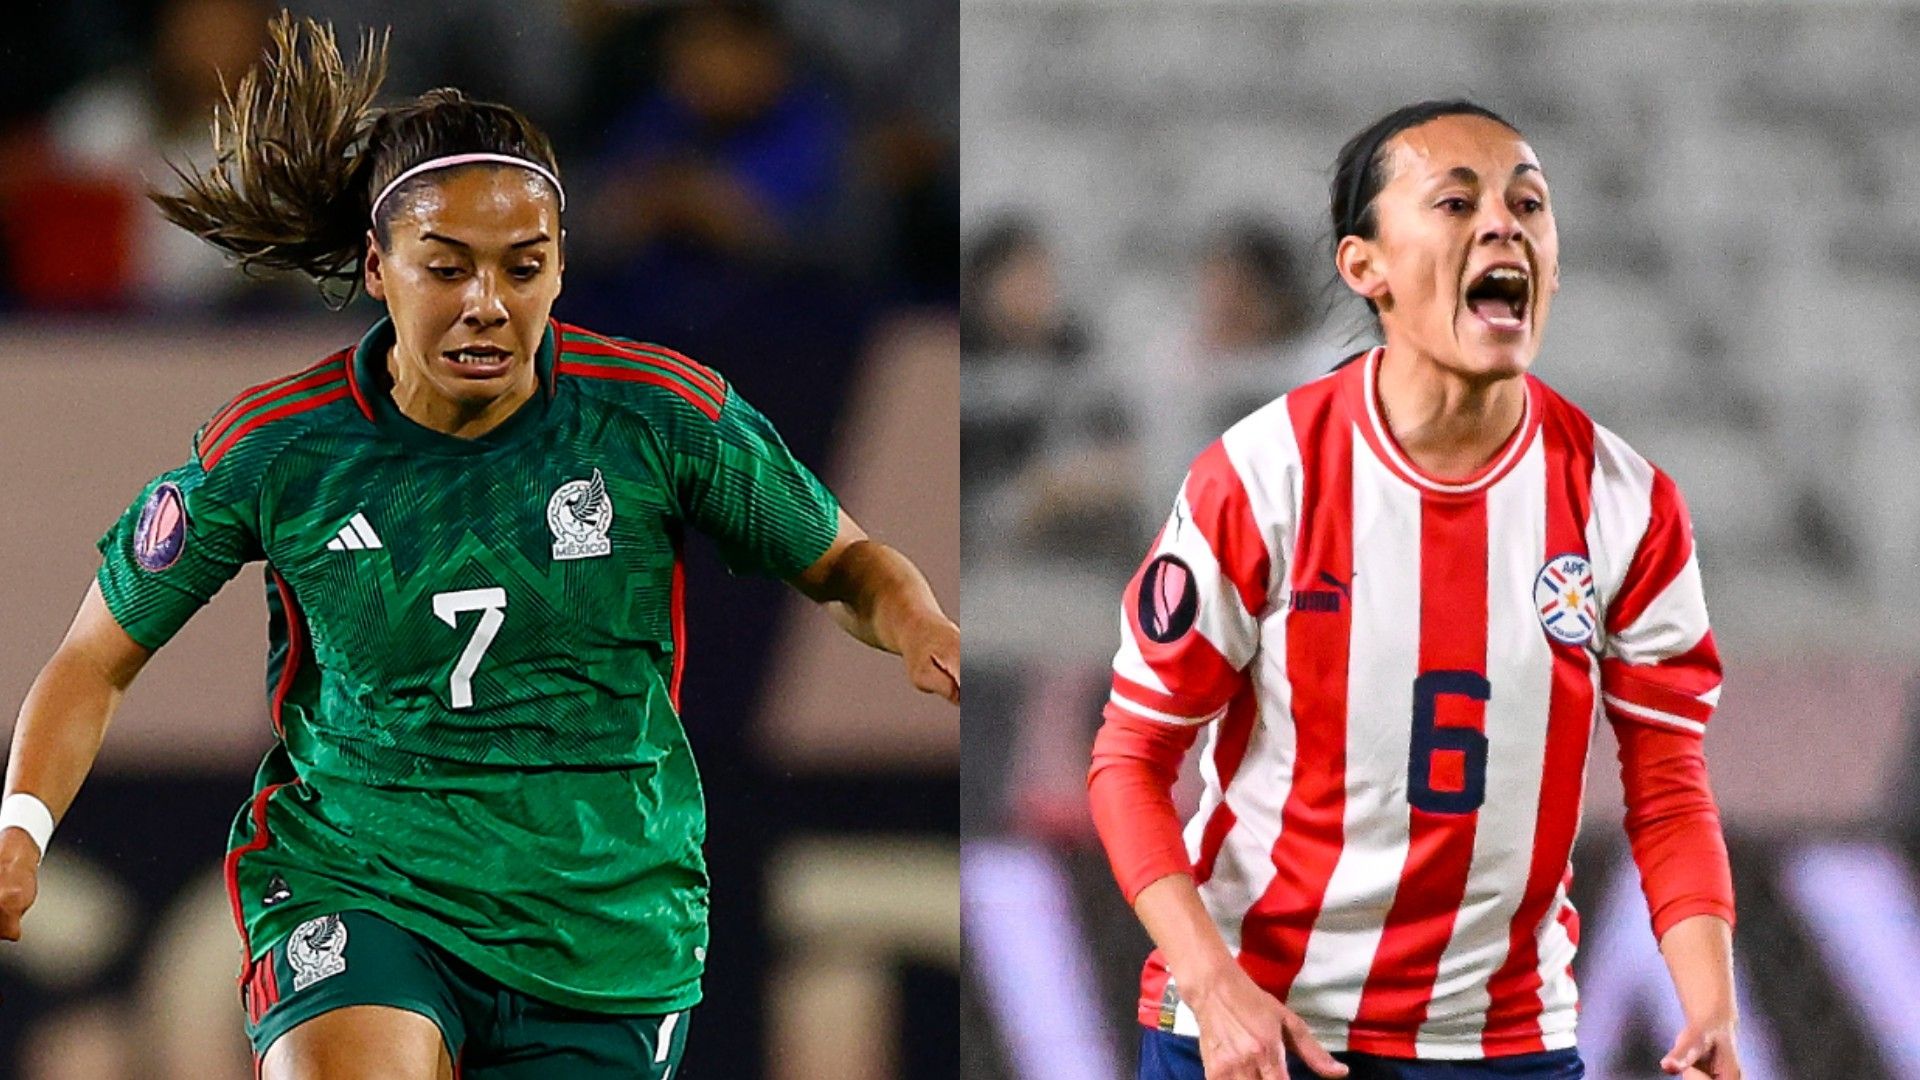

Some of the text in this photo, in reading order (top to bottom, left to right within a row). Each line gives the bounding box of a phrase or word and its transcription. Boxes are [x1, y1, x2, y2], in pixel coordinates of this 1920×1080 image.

[555, 541, 608, 556] MÉXICO
[1562, 561, 1584, 575] APF
[433, 587, 507, 708] 7
[1406, 670, 1491, 814] 6
